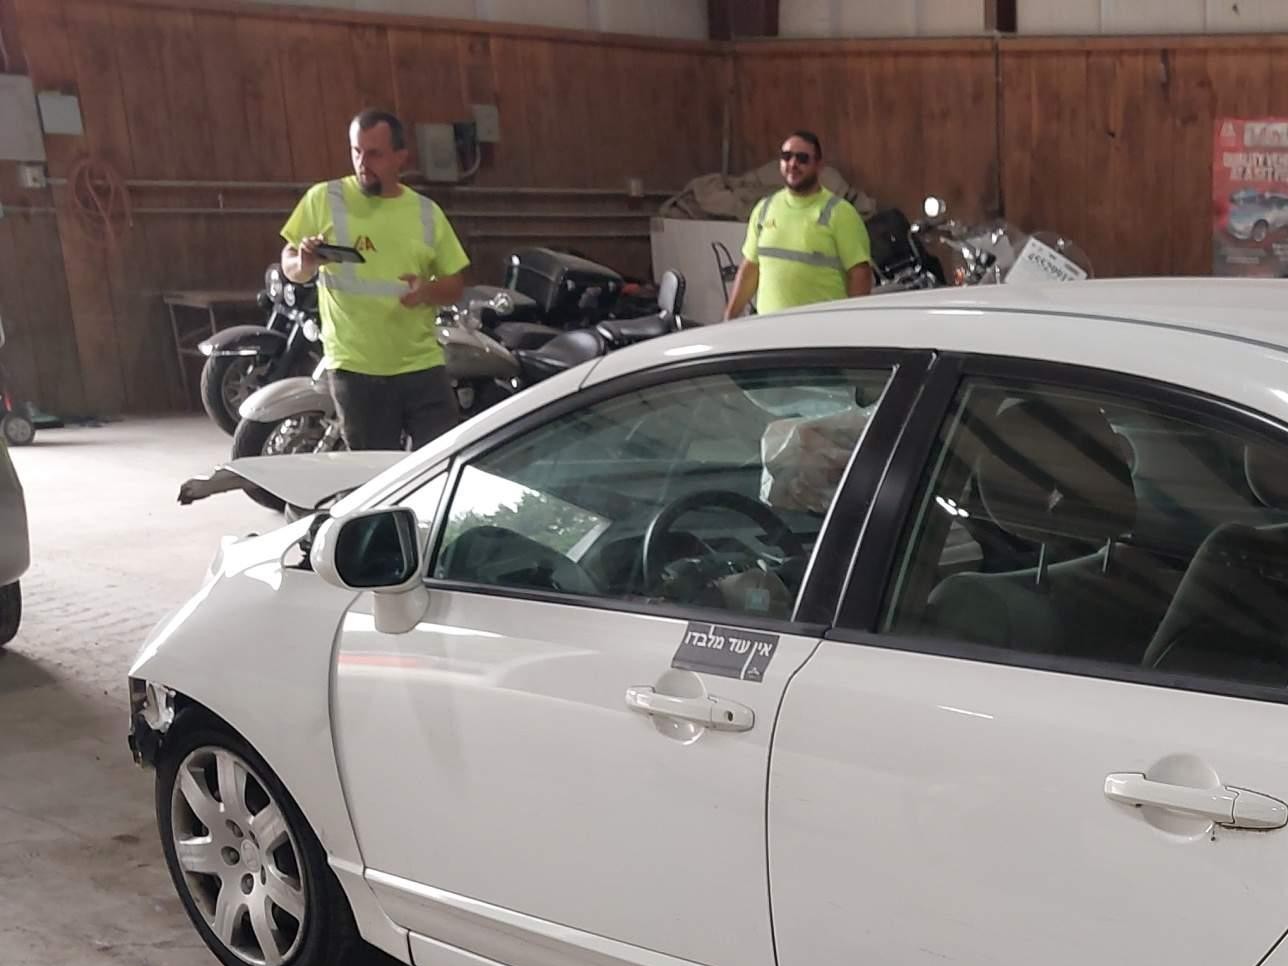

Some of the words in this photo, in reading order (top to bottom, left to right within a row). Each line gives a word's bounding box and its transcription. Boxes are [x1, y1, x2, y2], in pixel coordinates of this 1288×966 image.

[684, 624, 725, 650] מלבדו
[728, 637, 751, 654] עוד
[740, 641, 773, 680] אין
